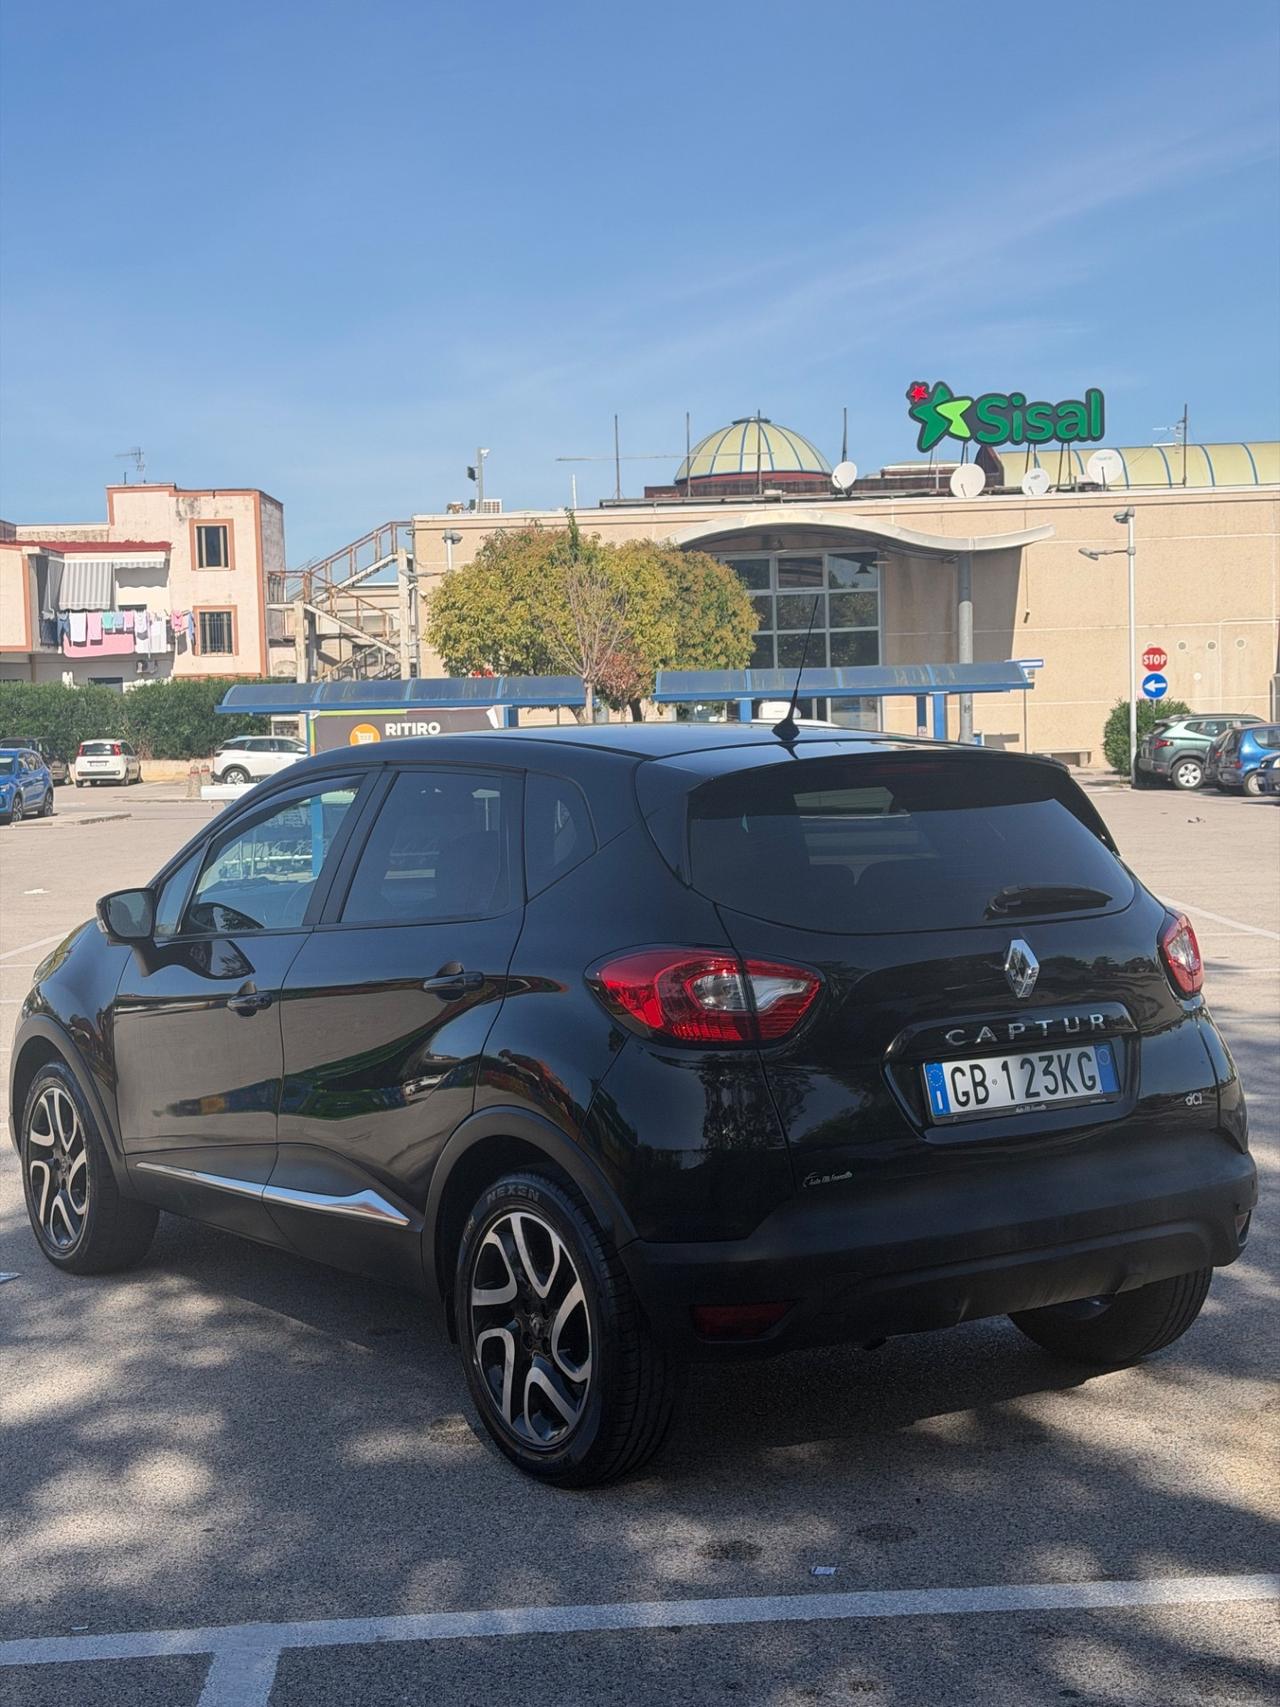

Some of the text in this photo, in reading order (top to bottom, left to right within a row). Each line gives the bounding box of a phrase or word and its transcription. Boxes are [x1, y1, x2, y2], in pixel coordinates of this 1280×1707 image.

[976, 390, 1101, 443] Sisal
[1143, 654, 1167, 665] STOP
[385, 722, 441, 736] RITIRO
[945, 1014, 1106, 1046] CAPTUR
[487, 1184, 539, 1204] NEXEN
